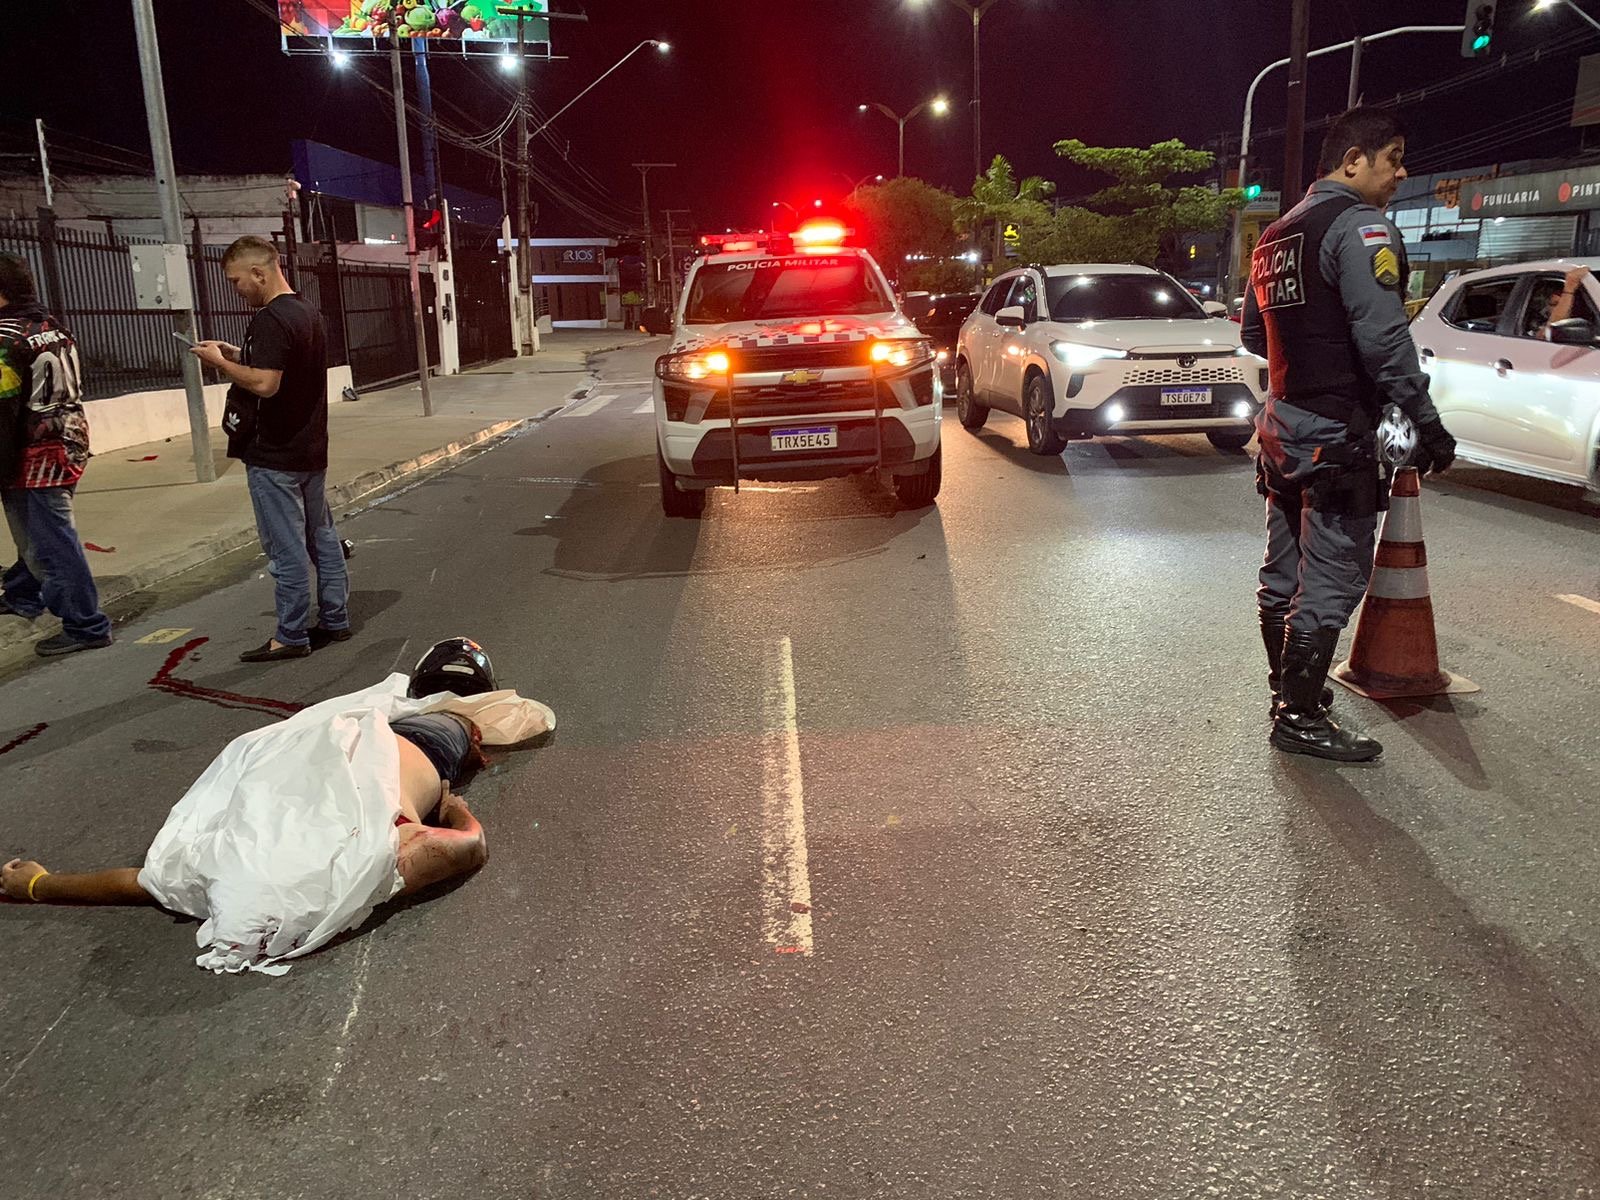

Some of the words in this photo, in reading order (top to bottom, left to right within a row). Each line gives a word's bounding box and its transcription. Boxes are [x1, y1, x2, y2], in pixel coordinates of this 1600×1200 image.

[1482, 190, 1540, 206] FUNILARIA
[563, 249, 593, 261] RIOS
[1252, 243, 1296, 279] POLÍCIA
[727, 260, 781, 271] POLÍCIA
[784, 259, 838, 267] MILITAR
[776, 434, 830, 449] TRX5E45
